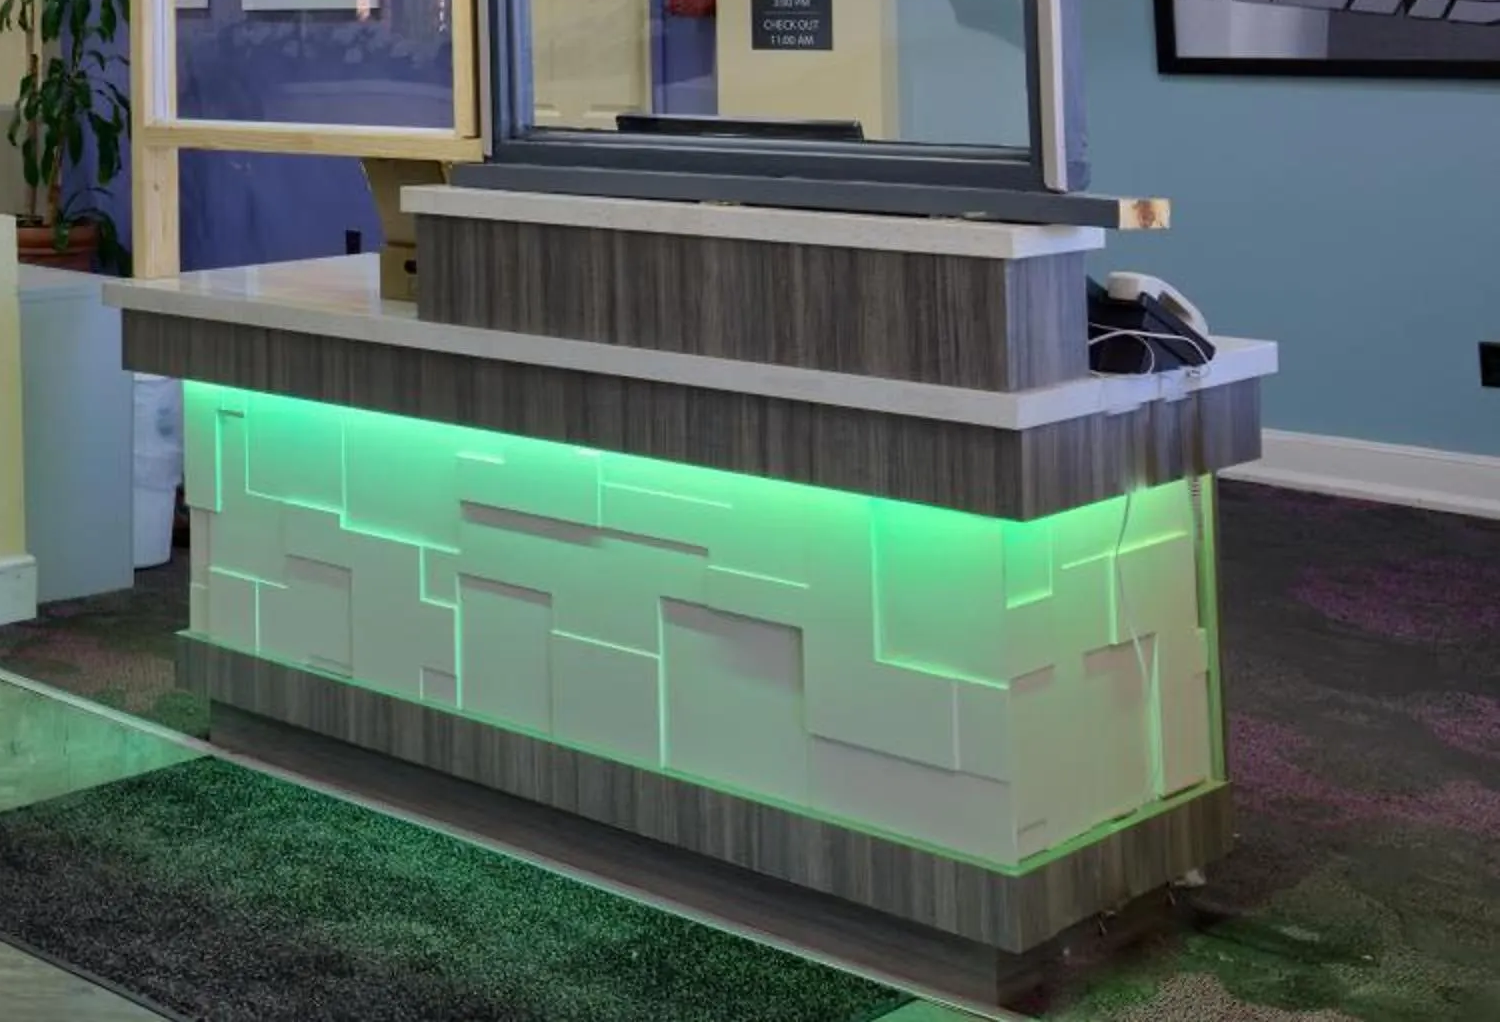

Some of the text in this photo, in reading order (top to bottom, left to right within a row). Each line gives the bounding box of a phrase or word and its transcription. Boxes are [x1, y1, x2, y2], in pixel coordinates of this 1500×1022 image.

[763, 18, 820, 31] CHECK OUT
[770, 33, 815, 47] 11:00 AM
